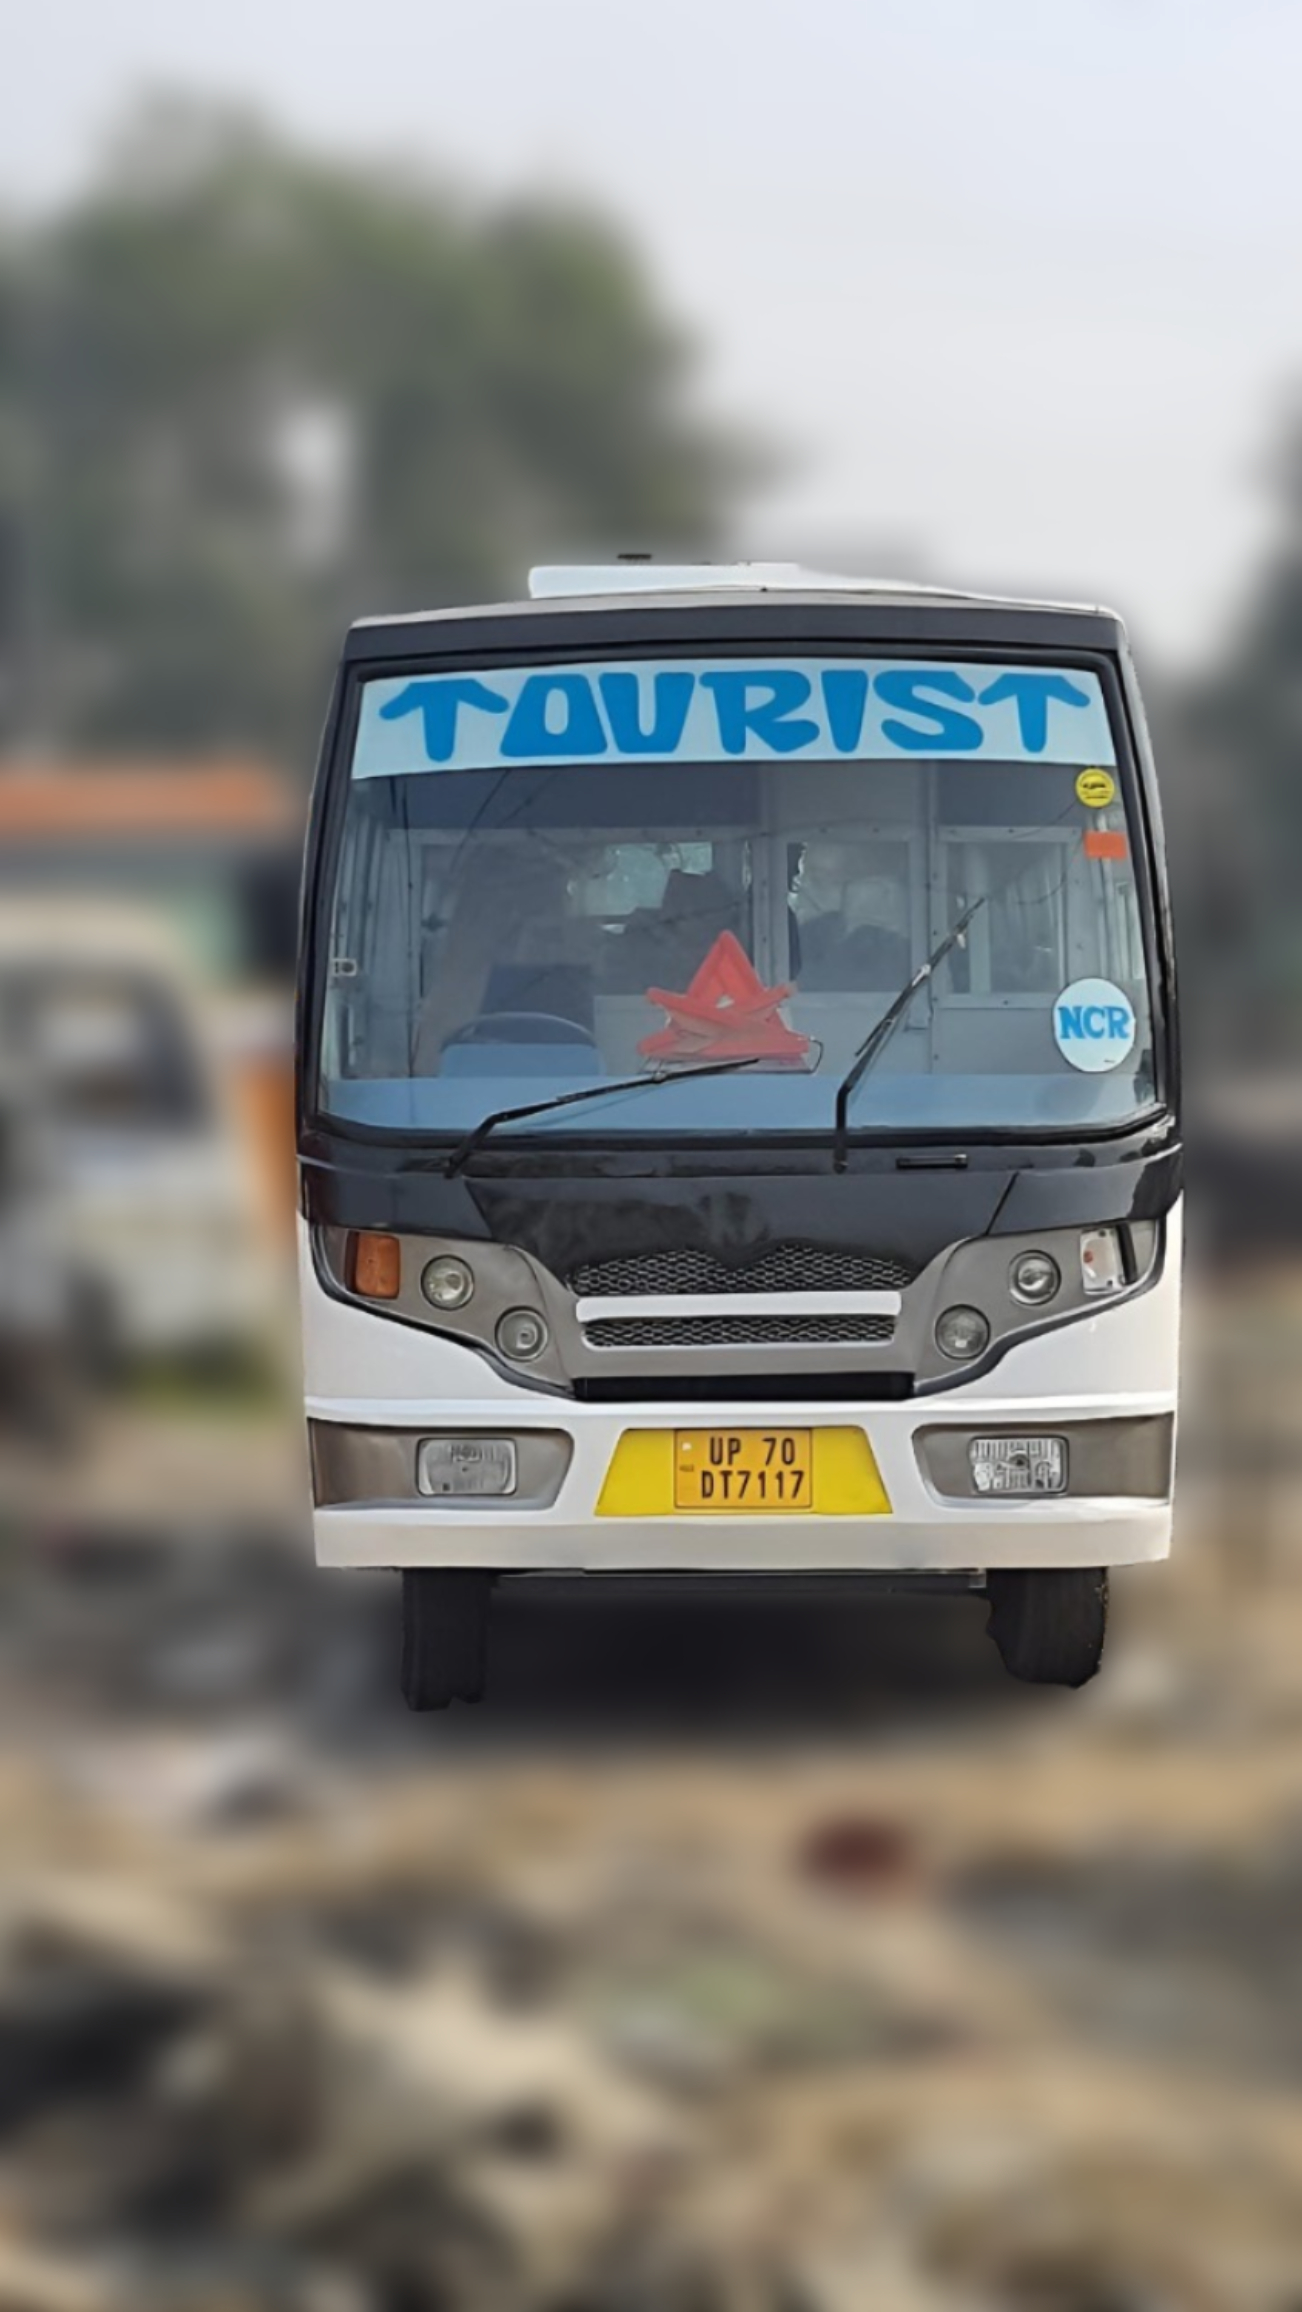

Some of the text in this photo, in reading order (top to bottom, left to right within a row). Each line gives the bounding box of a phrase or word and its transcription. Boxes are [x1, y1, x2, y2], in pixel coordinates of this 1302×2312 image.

[379, 669, 1090, 762] TOURIST
[1058, 1006, 1129, 1039] NCR
[710, 1437, 795, 1465] UP 70
[701, 1471, 804, 1498] DT7117
